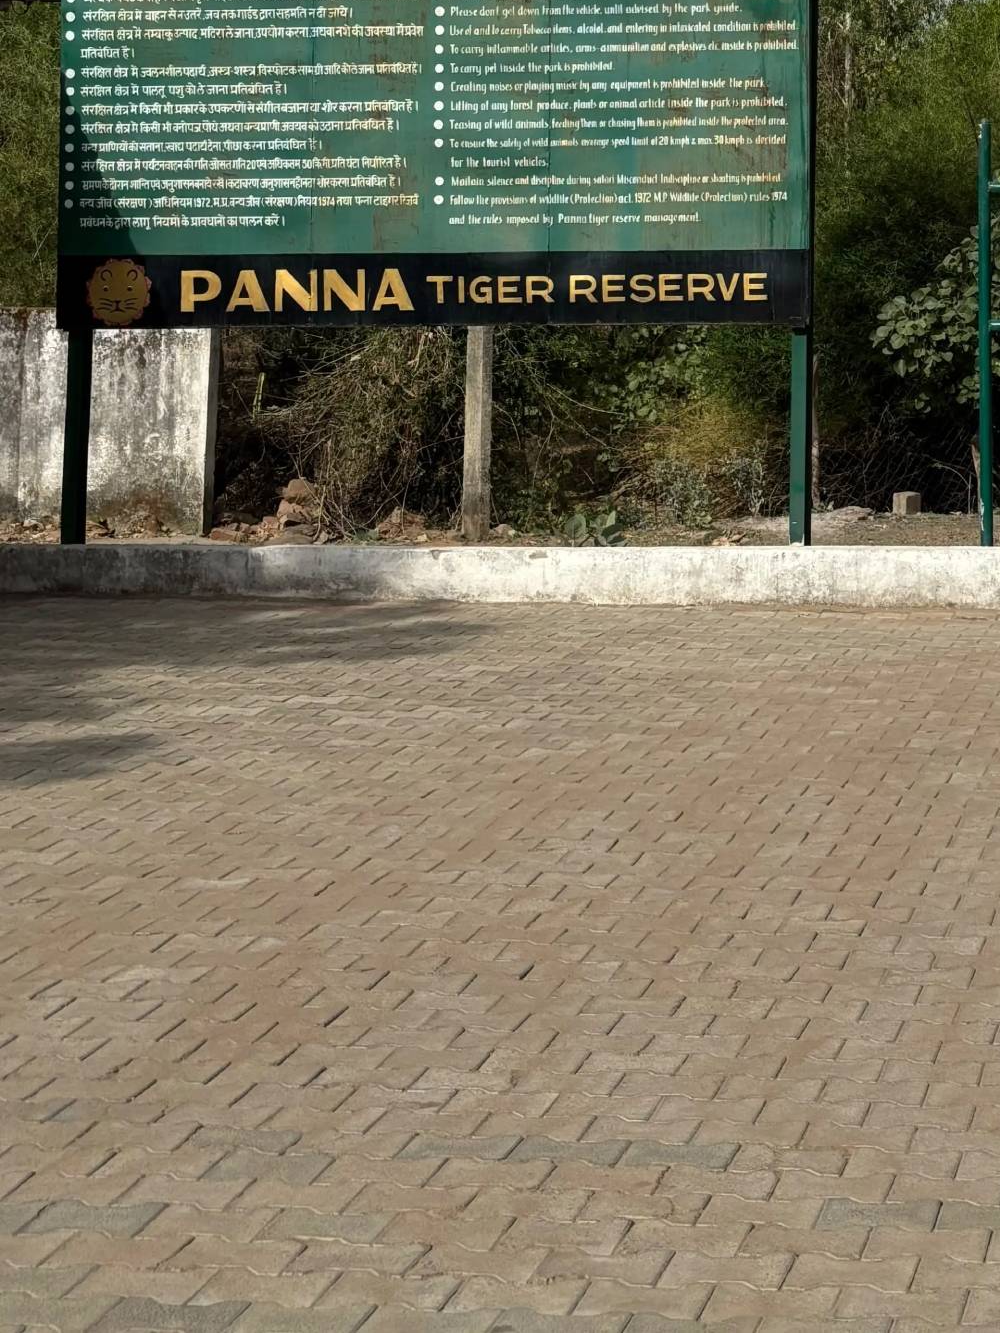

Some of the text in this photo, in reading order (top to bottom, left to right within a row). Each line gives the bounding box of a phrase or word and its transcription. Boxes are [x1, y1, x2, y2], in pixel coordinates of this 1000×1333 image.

[180, 268, 769, 313] PANNA TIGER RESERVE
